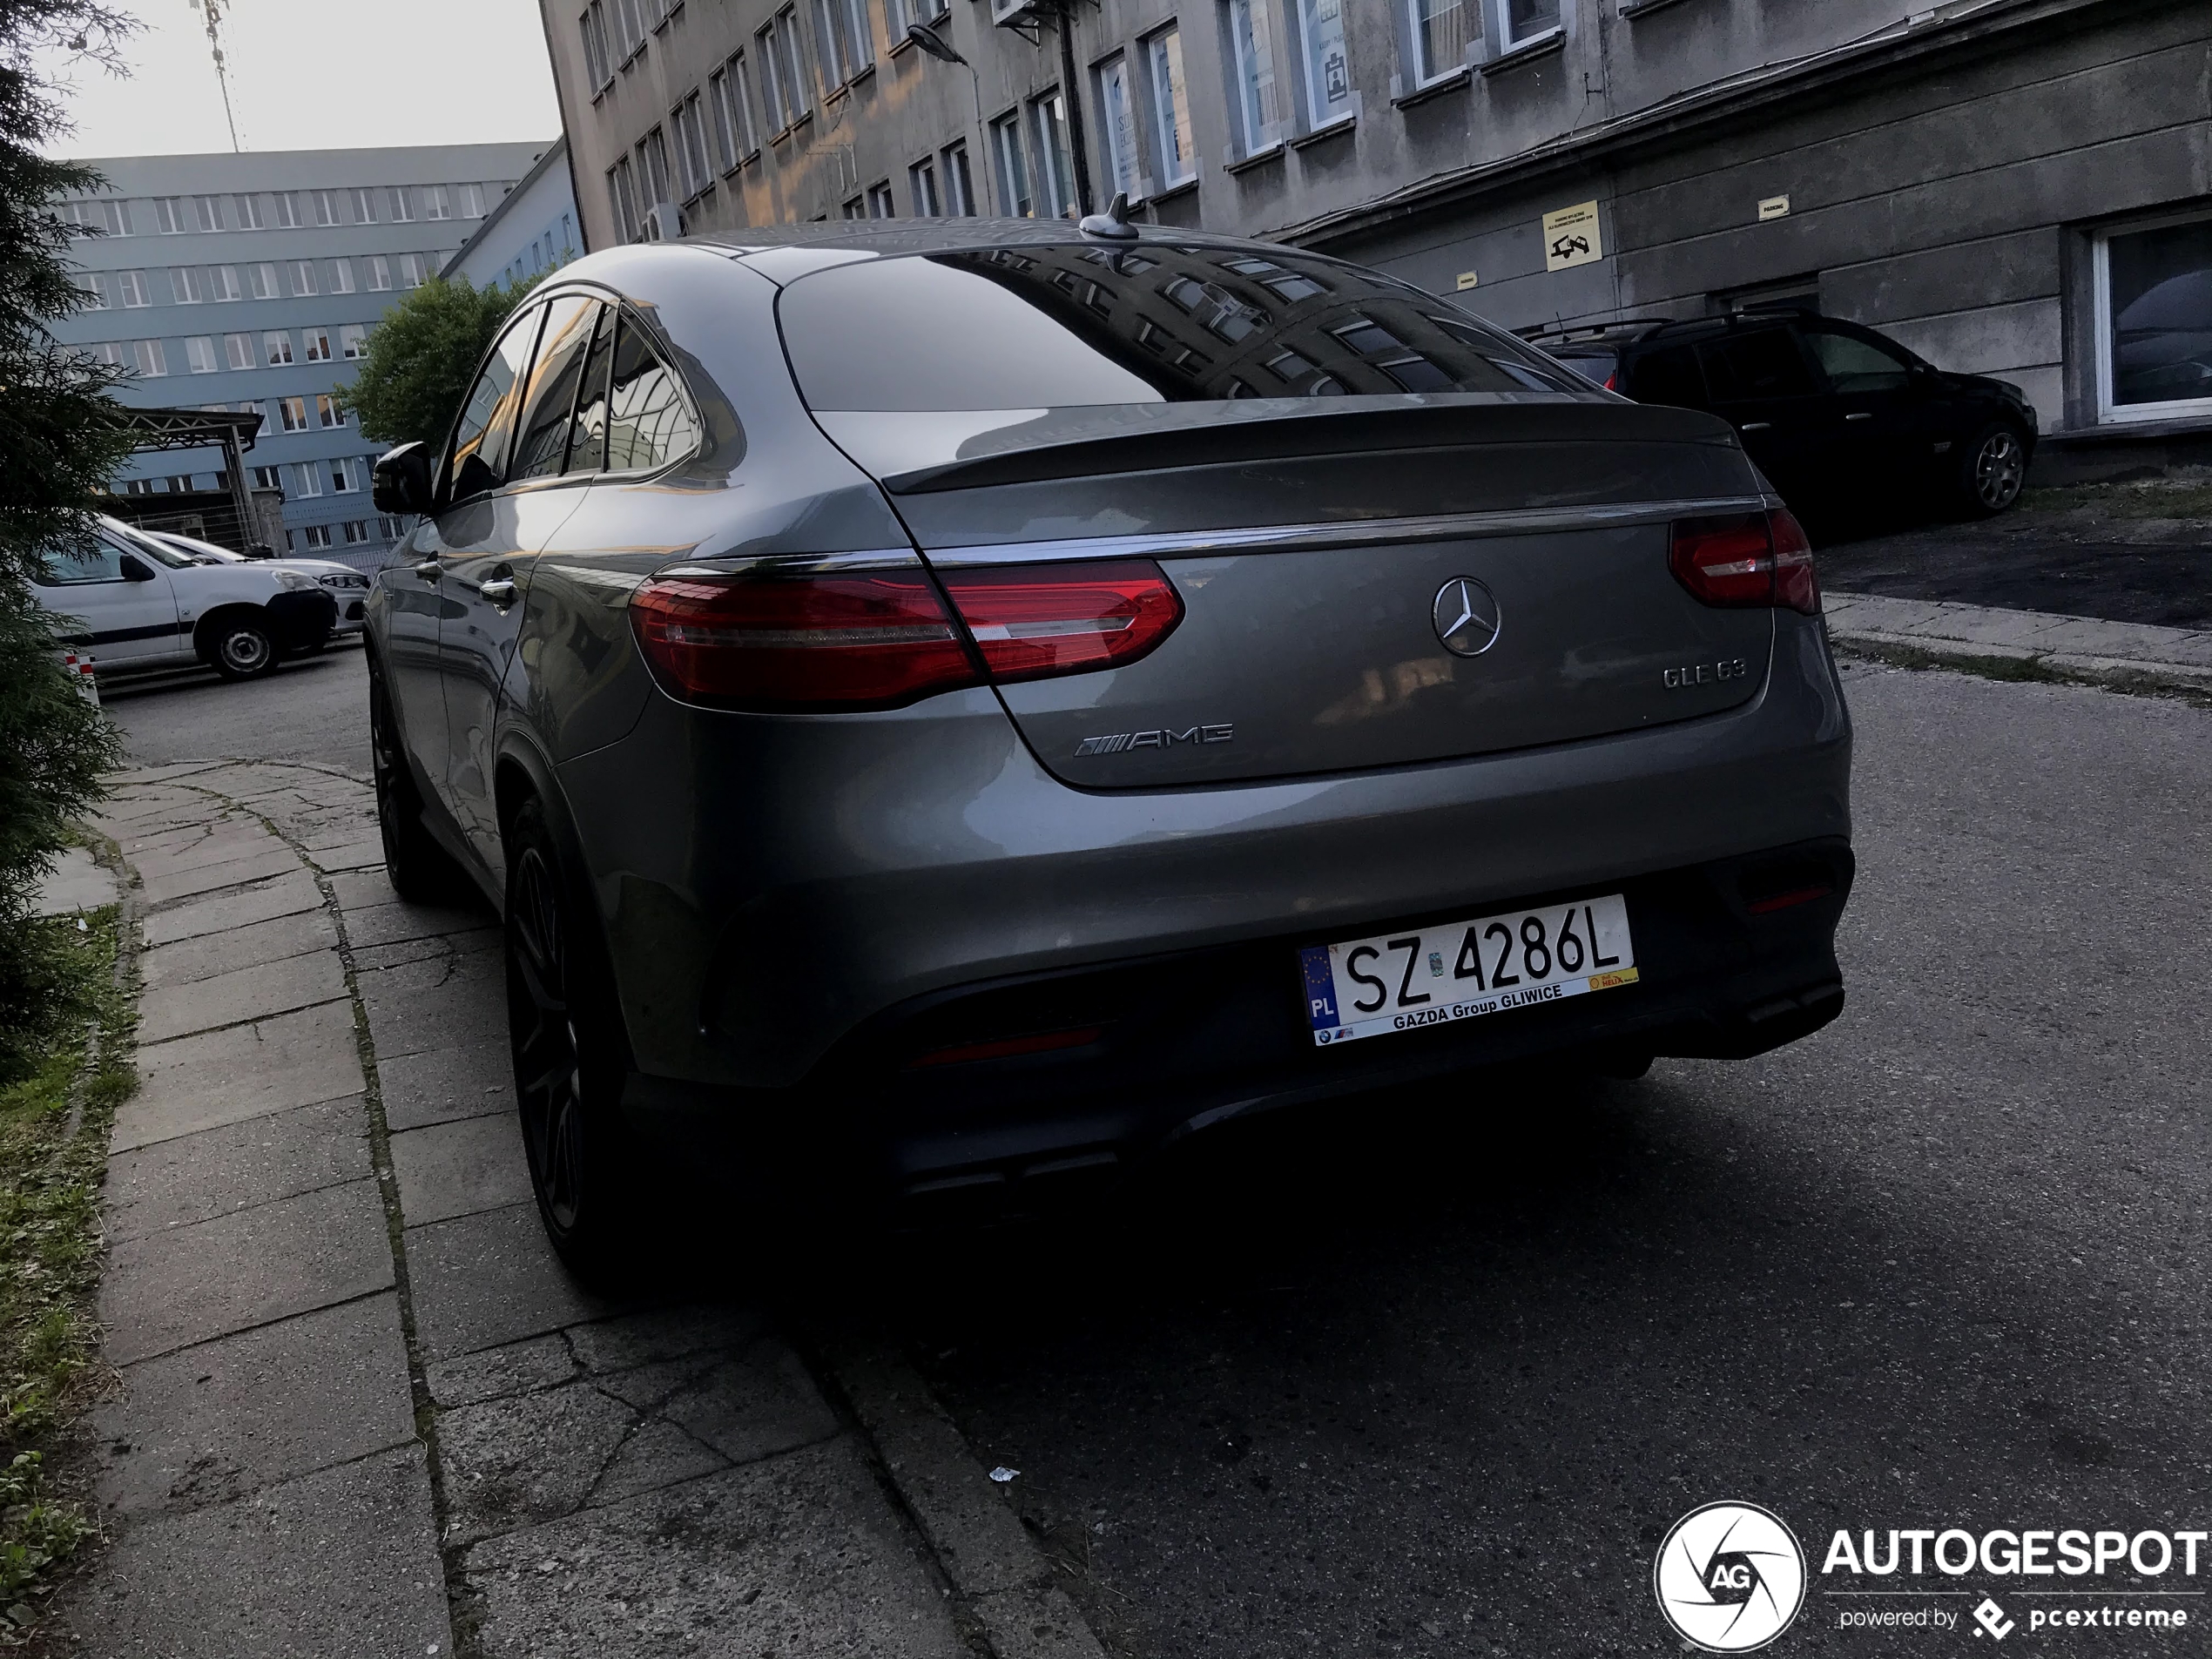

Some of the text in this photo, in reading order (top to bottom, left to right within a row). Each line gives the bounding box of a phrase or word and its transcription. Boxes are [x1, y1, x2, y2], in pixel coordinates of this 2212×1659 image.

[1764, 203, 1784, 212] PARKING
[1663, 658, 1746, 690] GLE 63
[1126, 723, 1234, 752] AMG
[1346, 905, 1621, 1014] SZ 4286L
[1602, 975, 1624, 988] HELIX
[1312, 999, 1335, 1018] PL
[1393, 983, 1563, 1030] GAZDA Group GLIWICE
